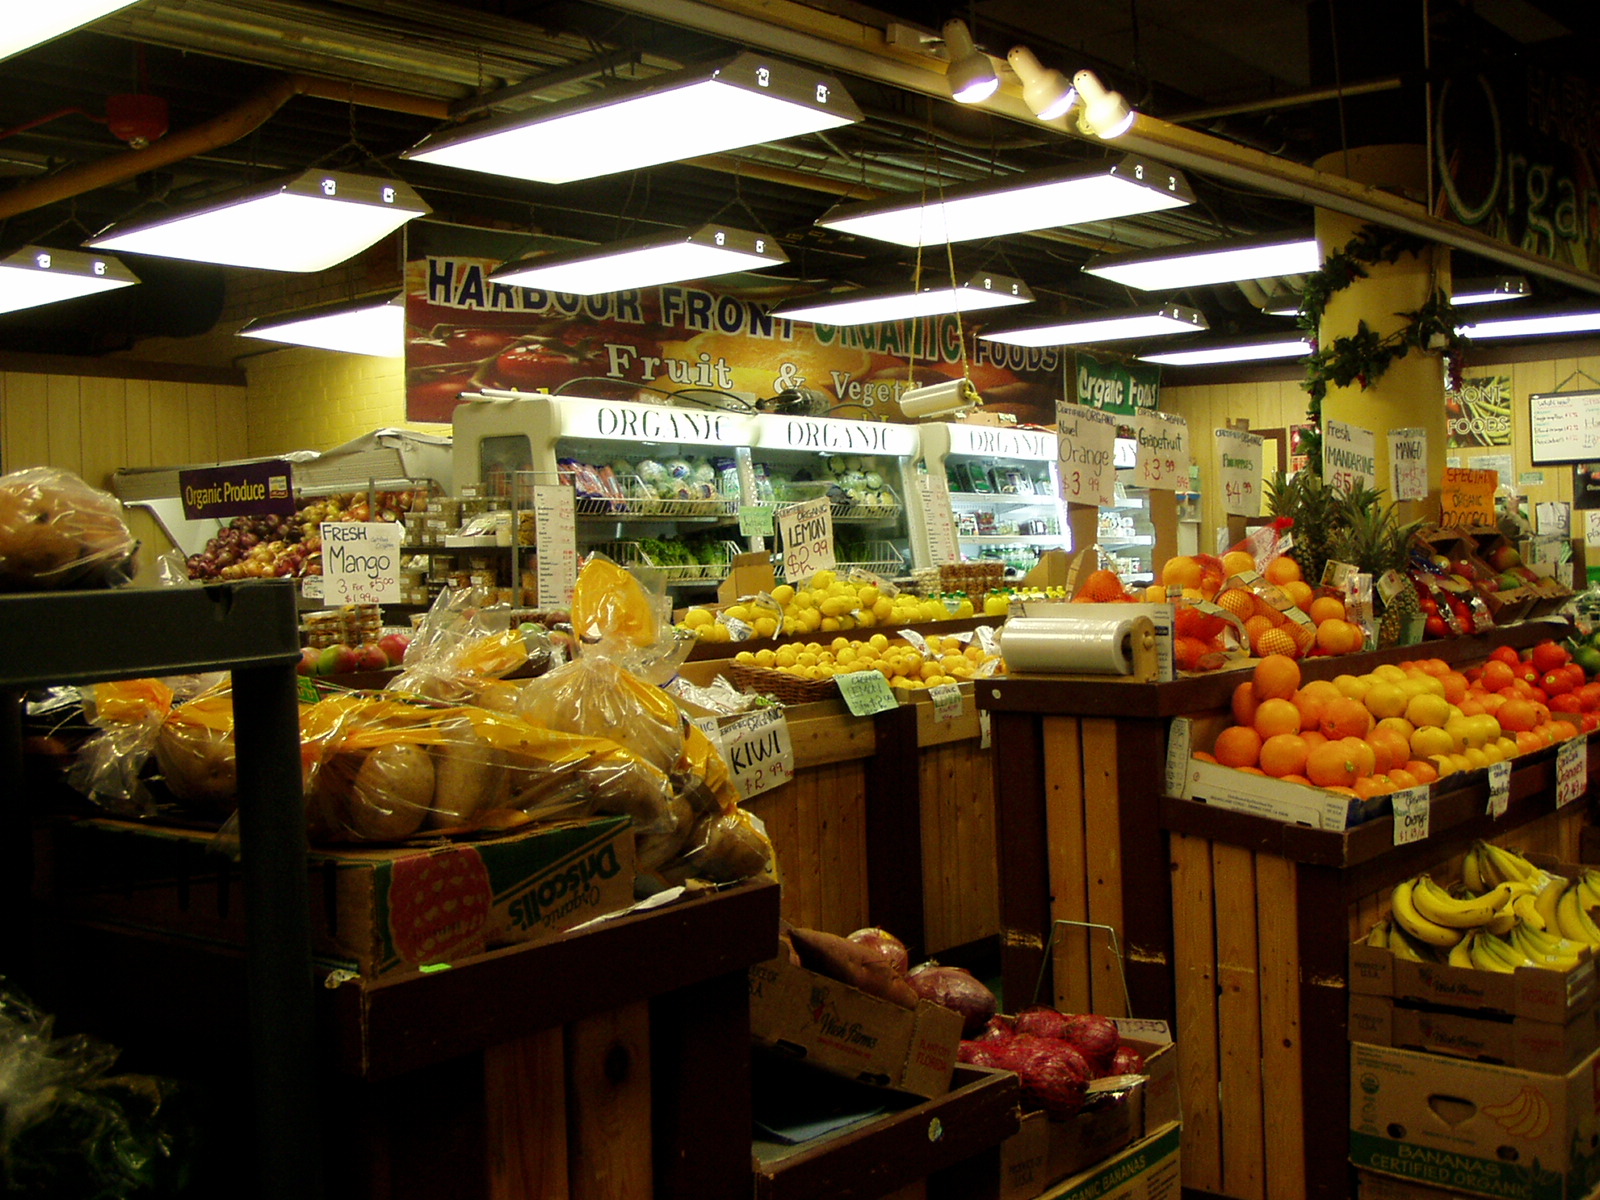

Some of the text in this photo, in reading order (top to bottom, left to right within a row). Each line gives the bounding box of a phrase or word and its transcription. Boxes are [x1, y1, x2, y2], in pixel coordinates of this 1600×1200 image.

[603, 342, 734, 389] Fruit
[598, 407, 730, 441] ORGANIC
[787, 421, 895, 451] ORGANIC
[1447, 416, 1508, 435] FOODS
[970, 430, 1050, 456] ORGANIC
[1059, 437, 1109, 477] Orange
[185, 481, 223, 510] Organic
[224, 479, 266, 503] Produce
[322, 524, 367, 541] FRESH
[788, 516, 827, 548] LEMON
[329, 545, 391, 579] Mango
[336, 578, 347, 594] 3
[731, 730, 781, 775] KIWI
[1102, 1154, 1147, 1191] BANANAS
[1370, 1153, 1531, 1198] CERTIFIED ORGANIC
[1398, 1144, 1501, 1177] BANANAS
